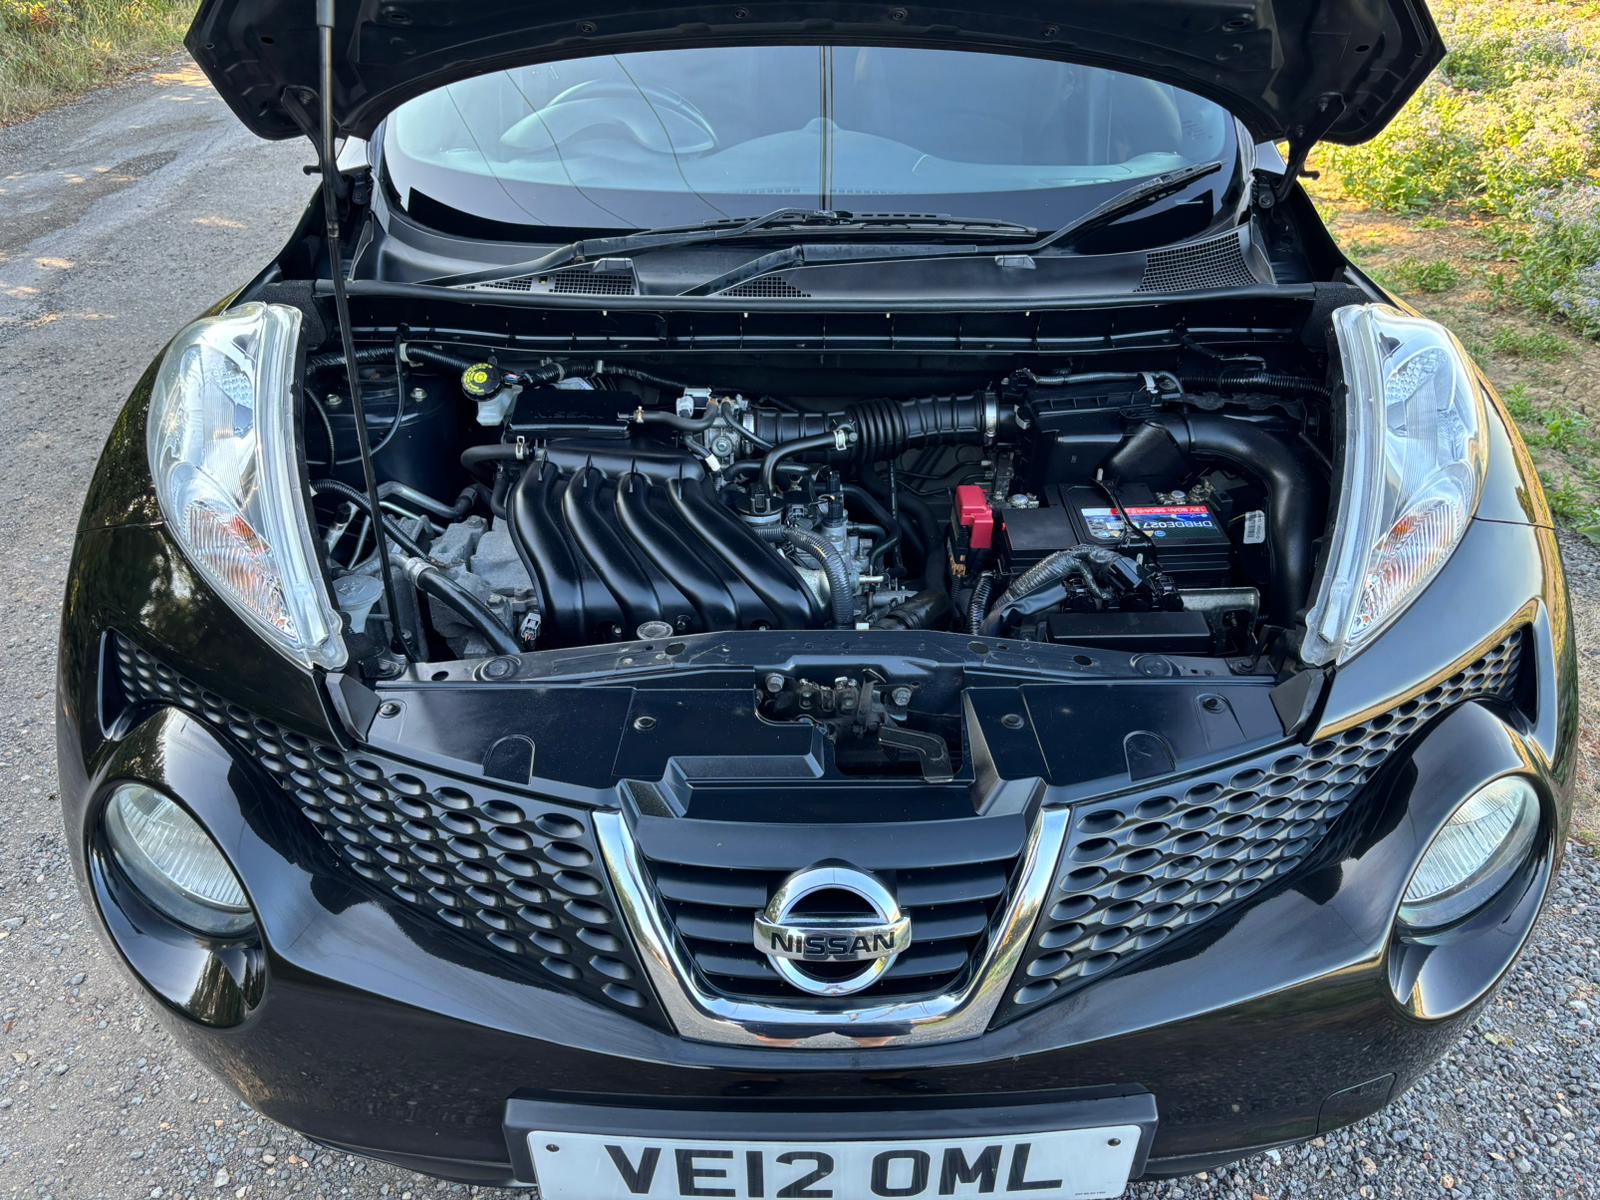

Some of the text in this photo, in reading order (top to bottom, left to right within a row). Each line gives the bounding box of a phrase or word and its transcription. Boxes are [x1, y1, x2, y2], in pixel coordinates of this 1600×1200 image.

[771, 931, 895, 956] NISSAN
[604, 1142, 1063, 1199] VE12 OML
